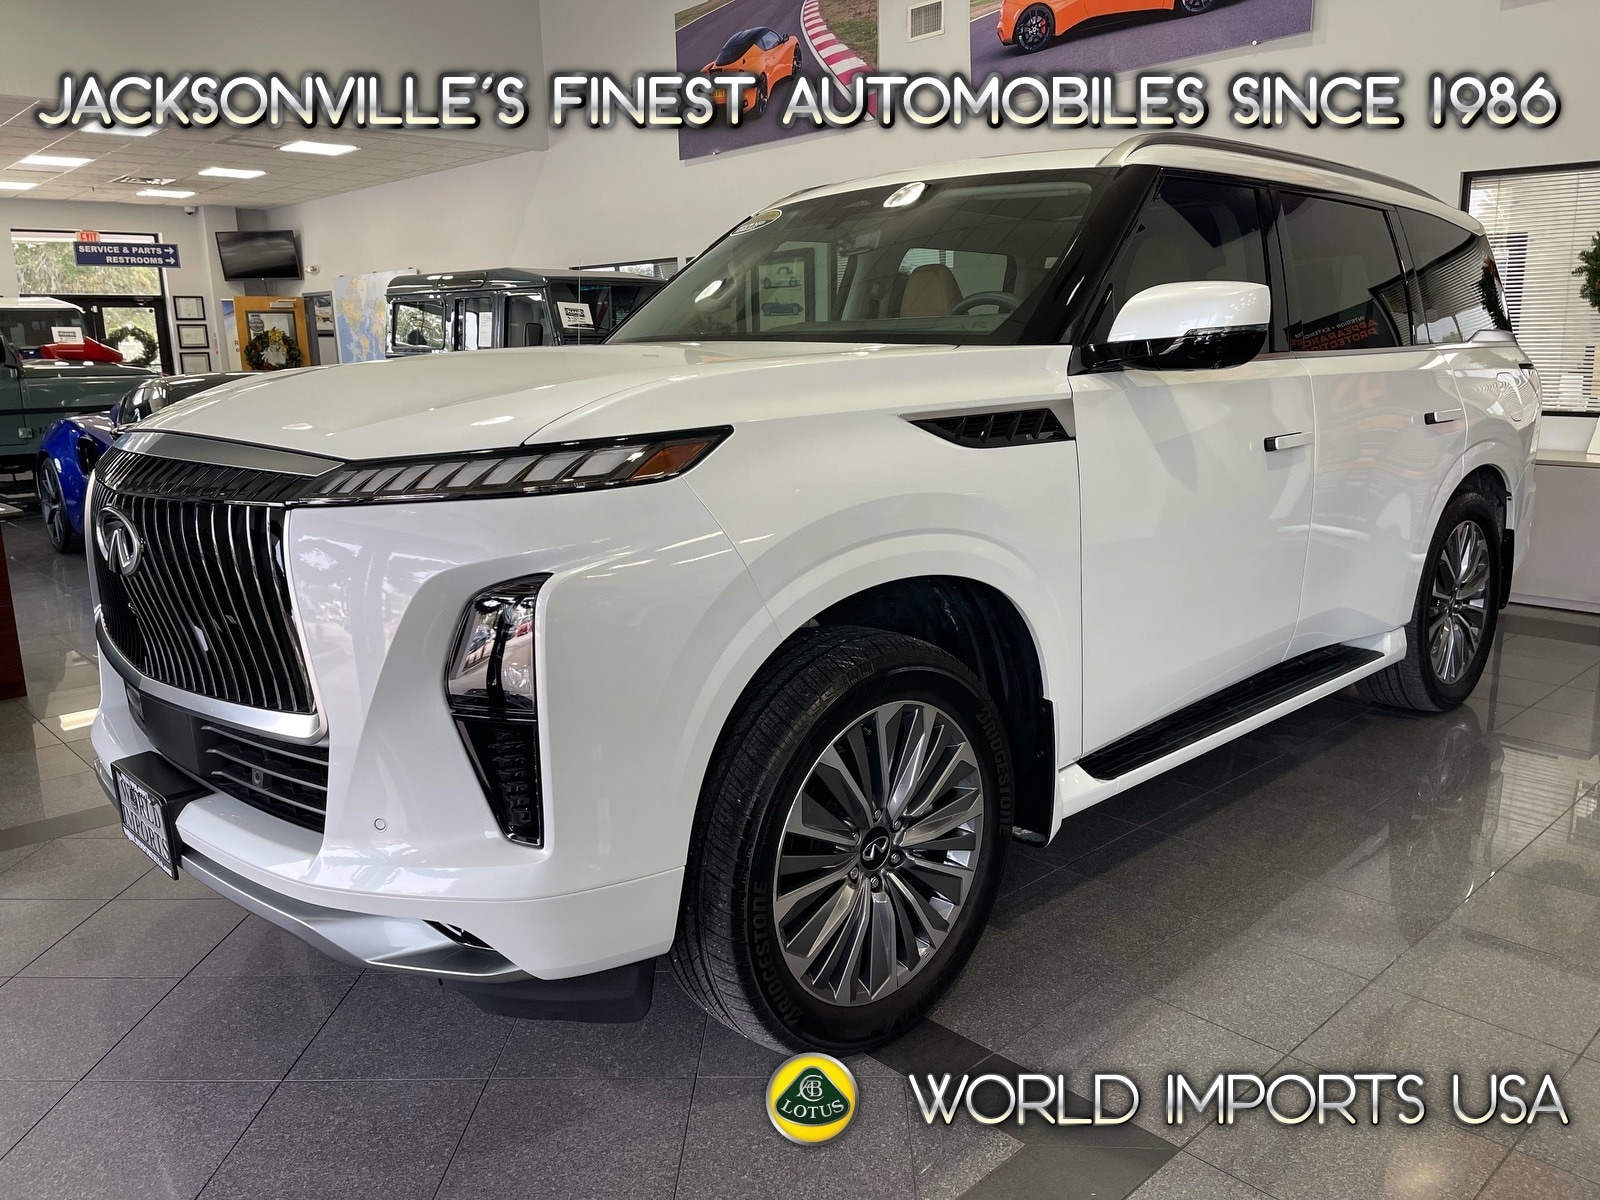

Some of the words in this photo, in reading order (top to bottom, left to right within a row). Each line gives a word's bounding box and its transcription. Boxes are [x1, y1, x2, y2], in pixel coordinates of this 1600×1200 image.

[78, 245, 120, 254] SERVICE
[122, 246, 130, 254] &
[131, 247, 163, 255] PARTS
[80, 232, 97, 243] EXIT
[106, 256, 164, 265] RESTROOMS
[975, 707, 1013, 837] BRIDGESTONE
[119, 779, 161, 829] WORLD
[121, 804, 171, 861] IMPORTS
[752, 880, 804, 1026] BRIDGESTONE
